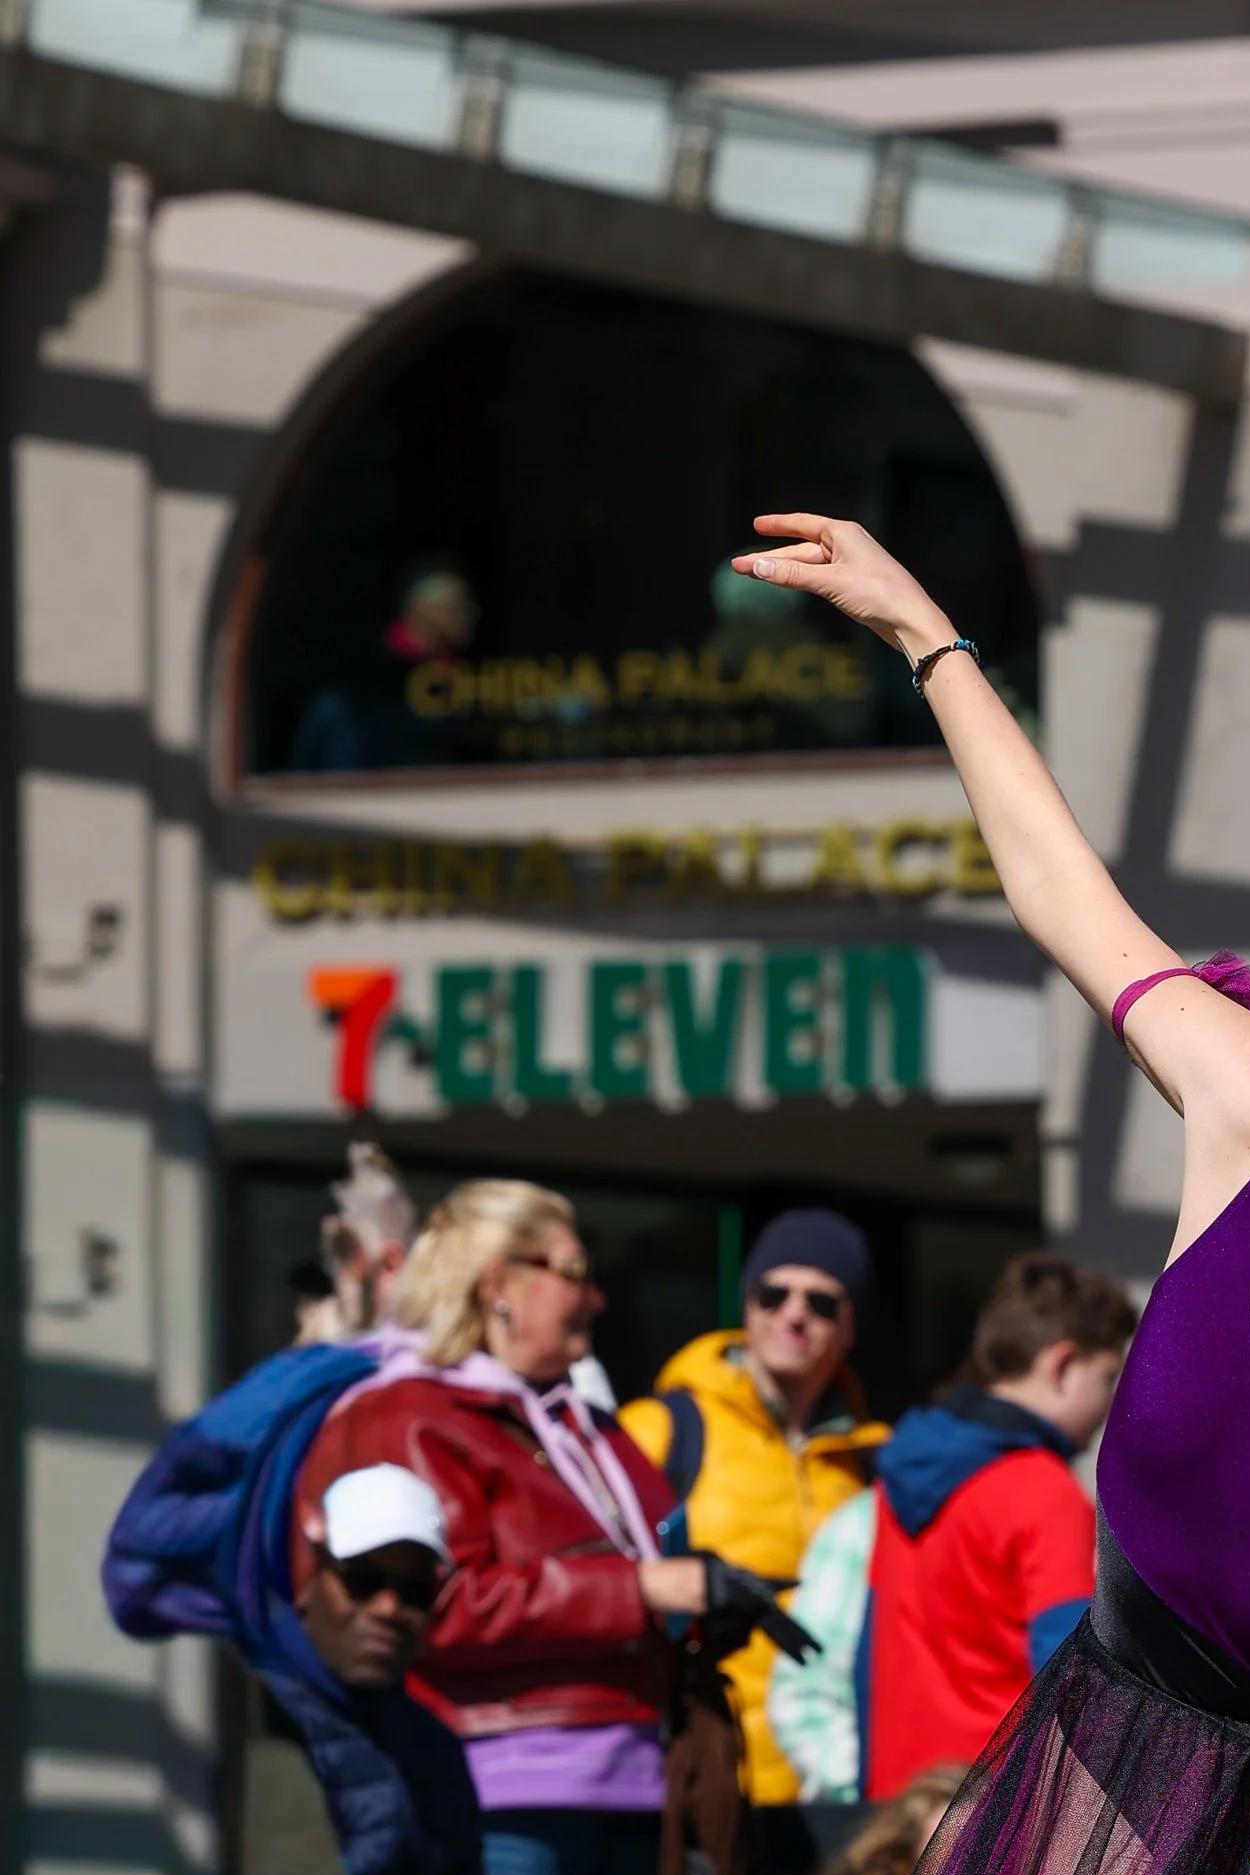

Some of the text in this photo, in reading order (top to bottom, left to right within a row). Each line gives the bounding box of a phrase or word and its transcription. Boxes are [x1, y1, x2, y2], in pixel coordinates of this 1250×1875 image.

[405, 643, 867, 719] CHINA PALACE
[250, 818, 1004, 920] CHINA PALACE
